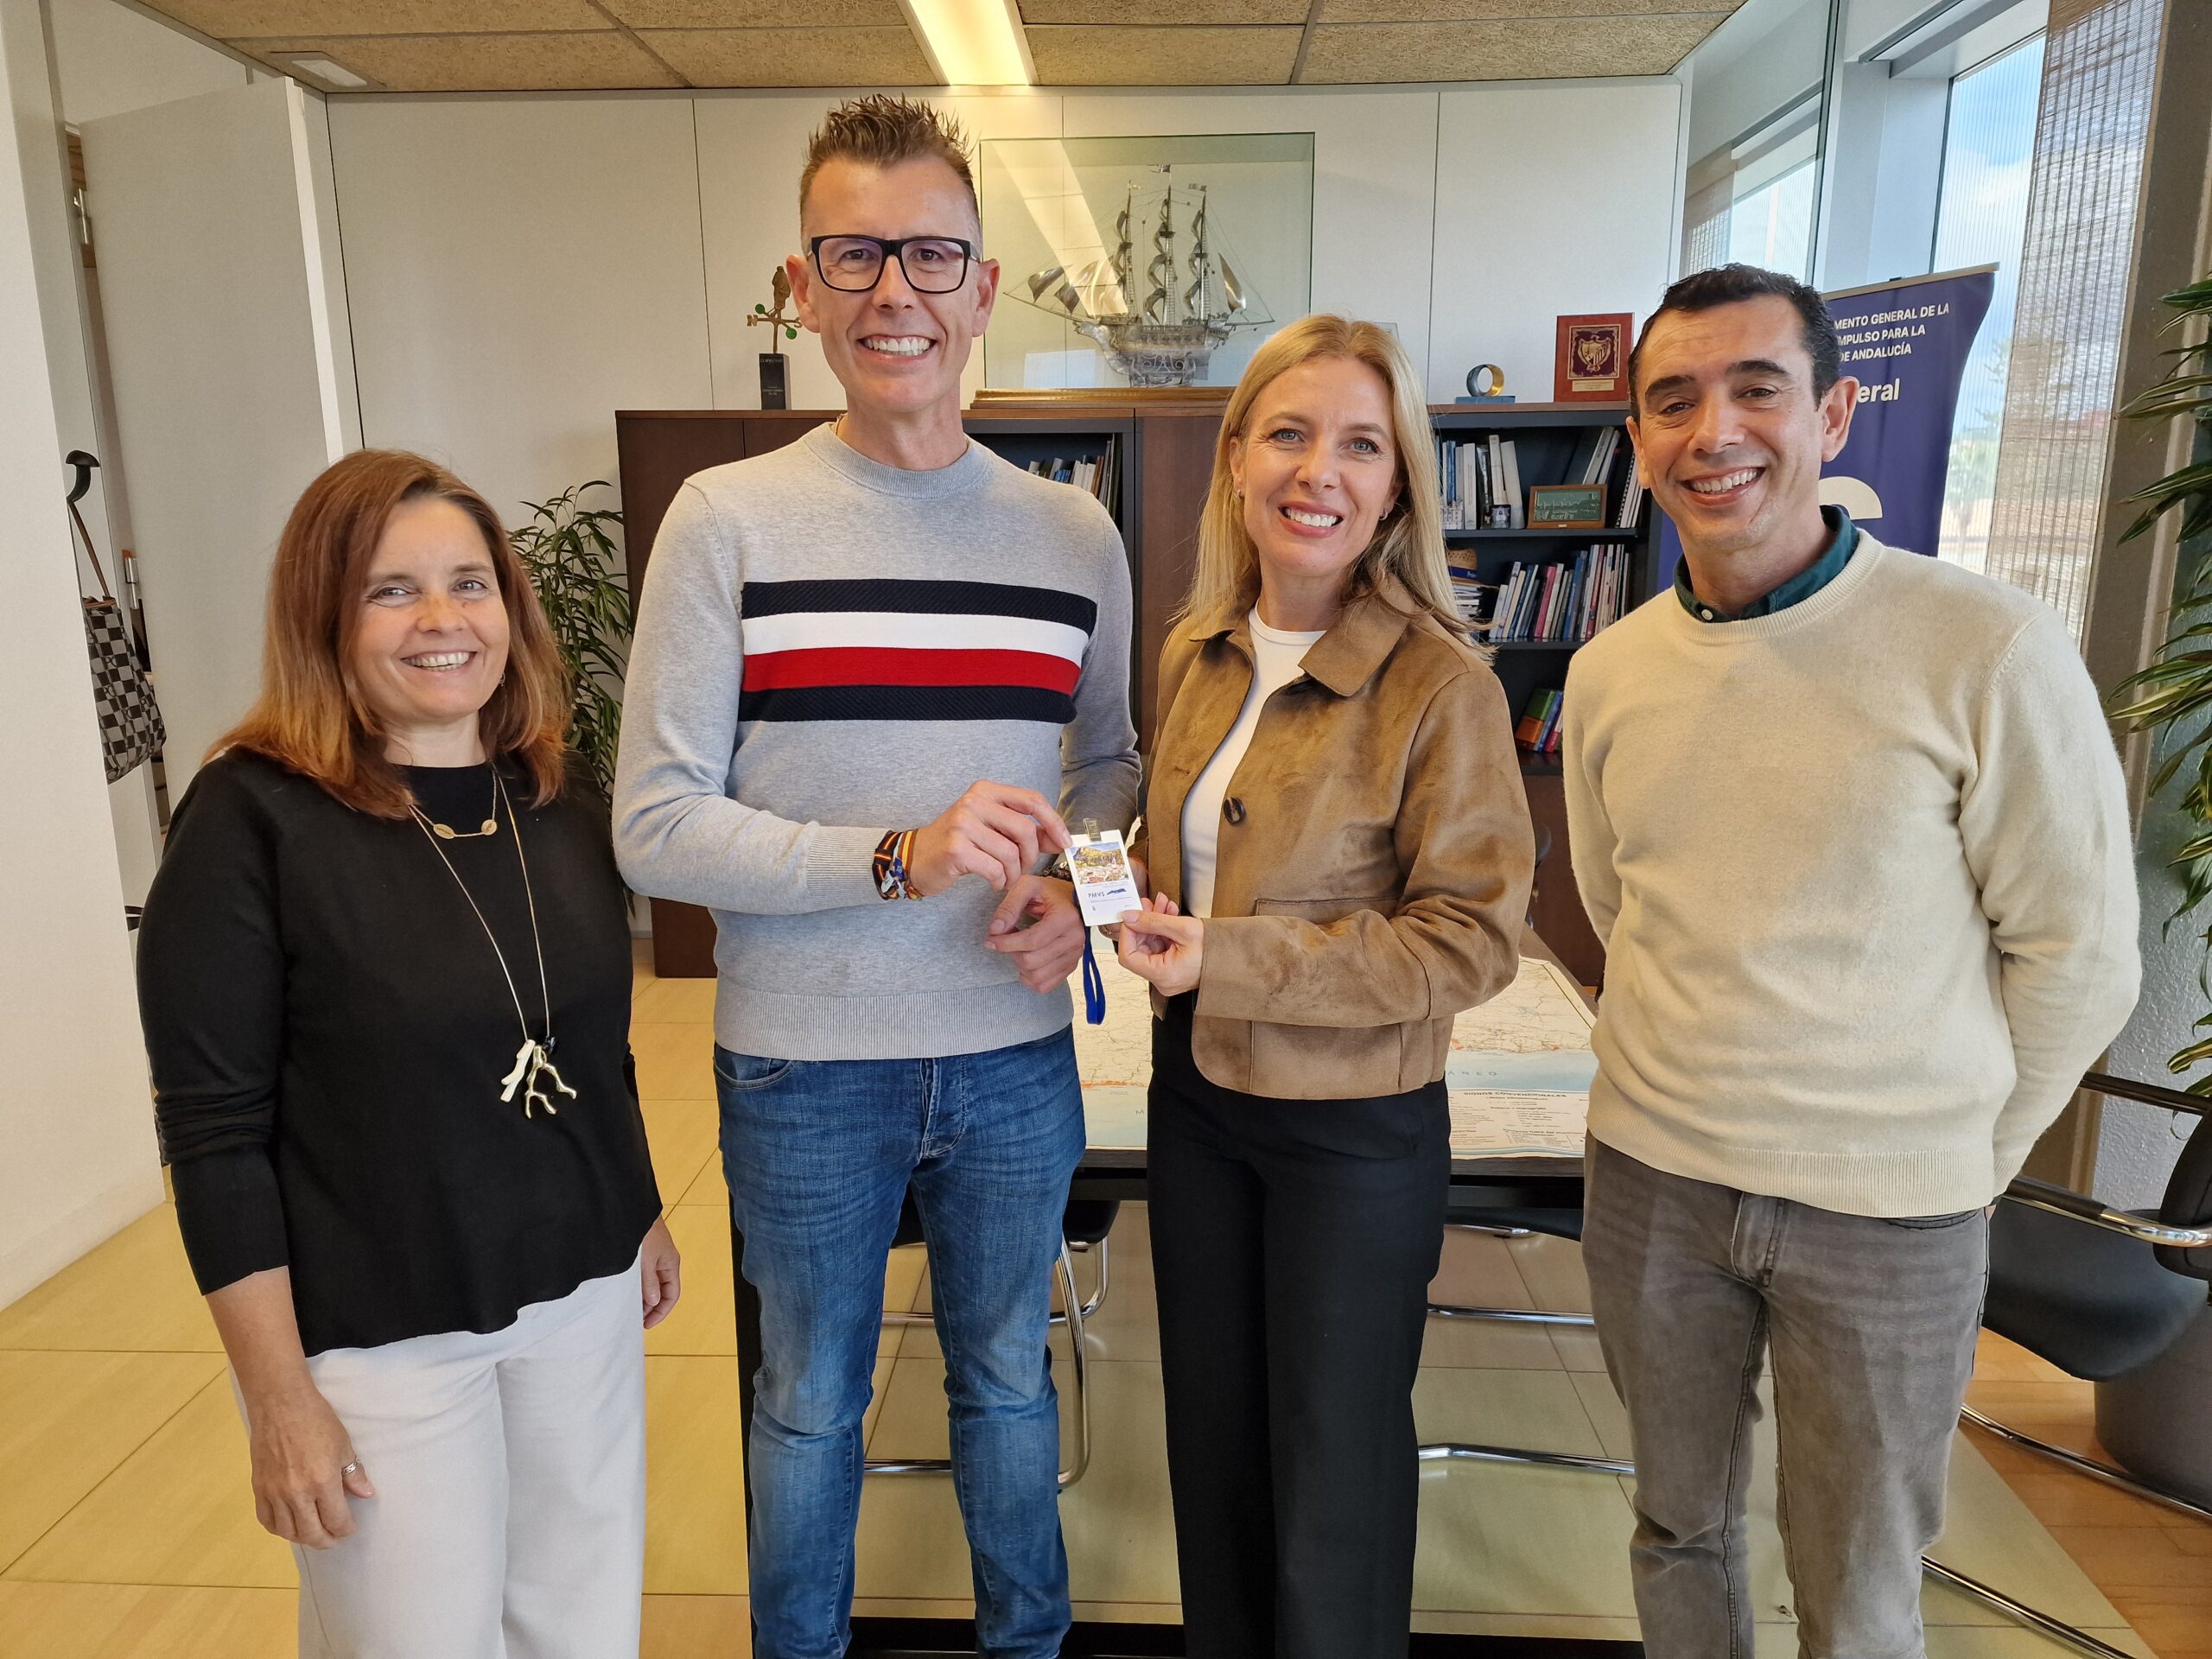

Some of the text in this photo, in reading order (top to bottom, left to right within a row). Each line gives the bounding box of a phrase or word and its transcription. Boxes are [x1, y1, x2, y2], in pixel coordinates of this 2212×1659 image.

[1871, 308, 1918, 325] GENERAL
[1920, 304, 1936, 318] DE
[1937, 302, 1950, 315] LA
[1881, 326, 1909, 340] PARA
[1910, 324, 1926, 337] LA
[1851, 341, 1912, 361] ANDALUCÍA
